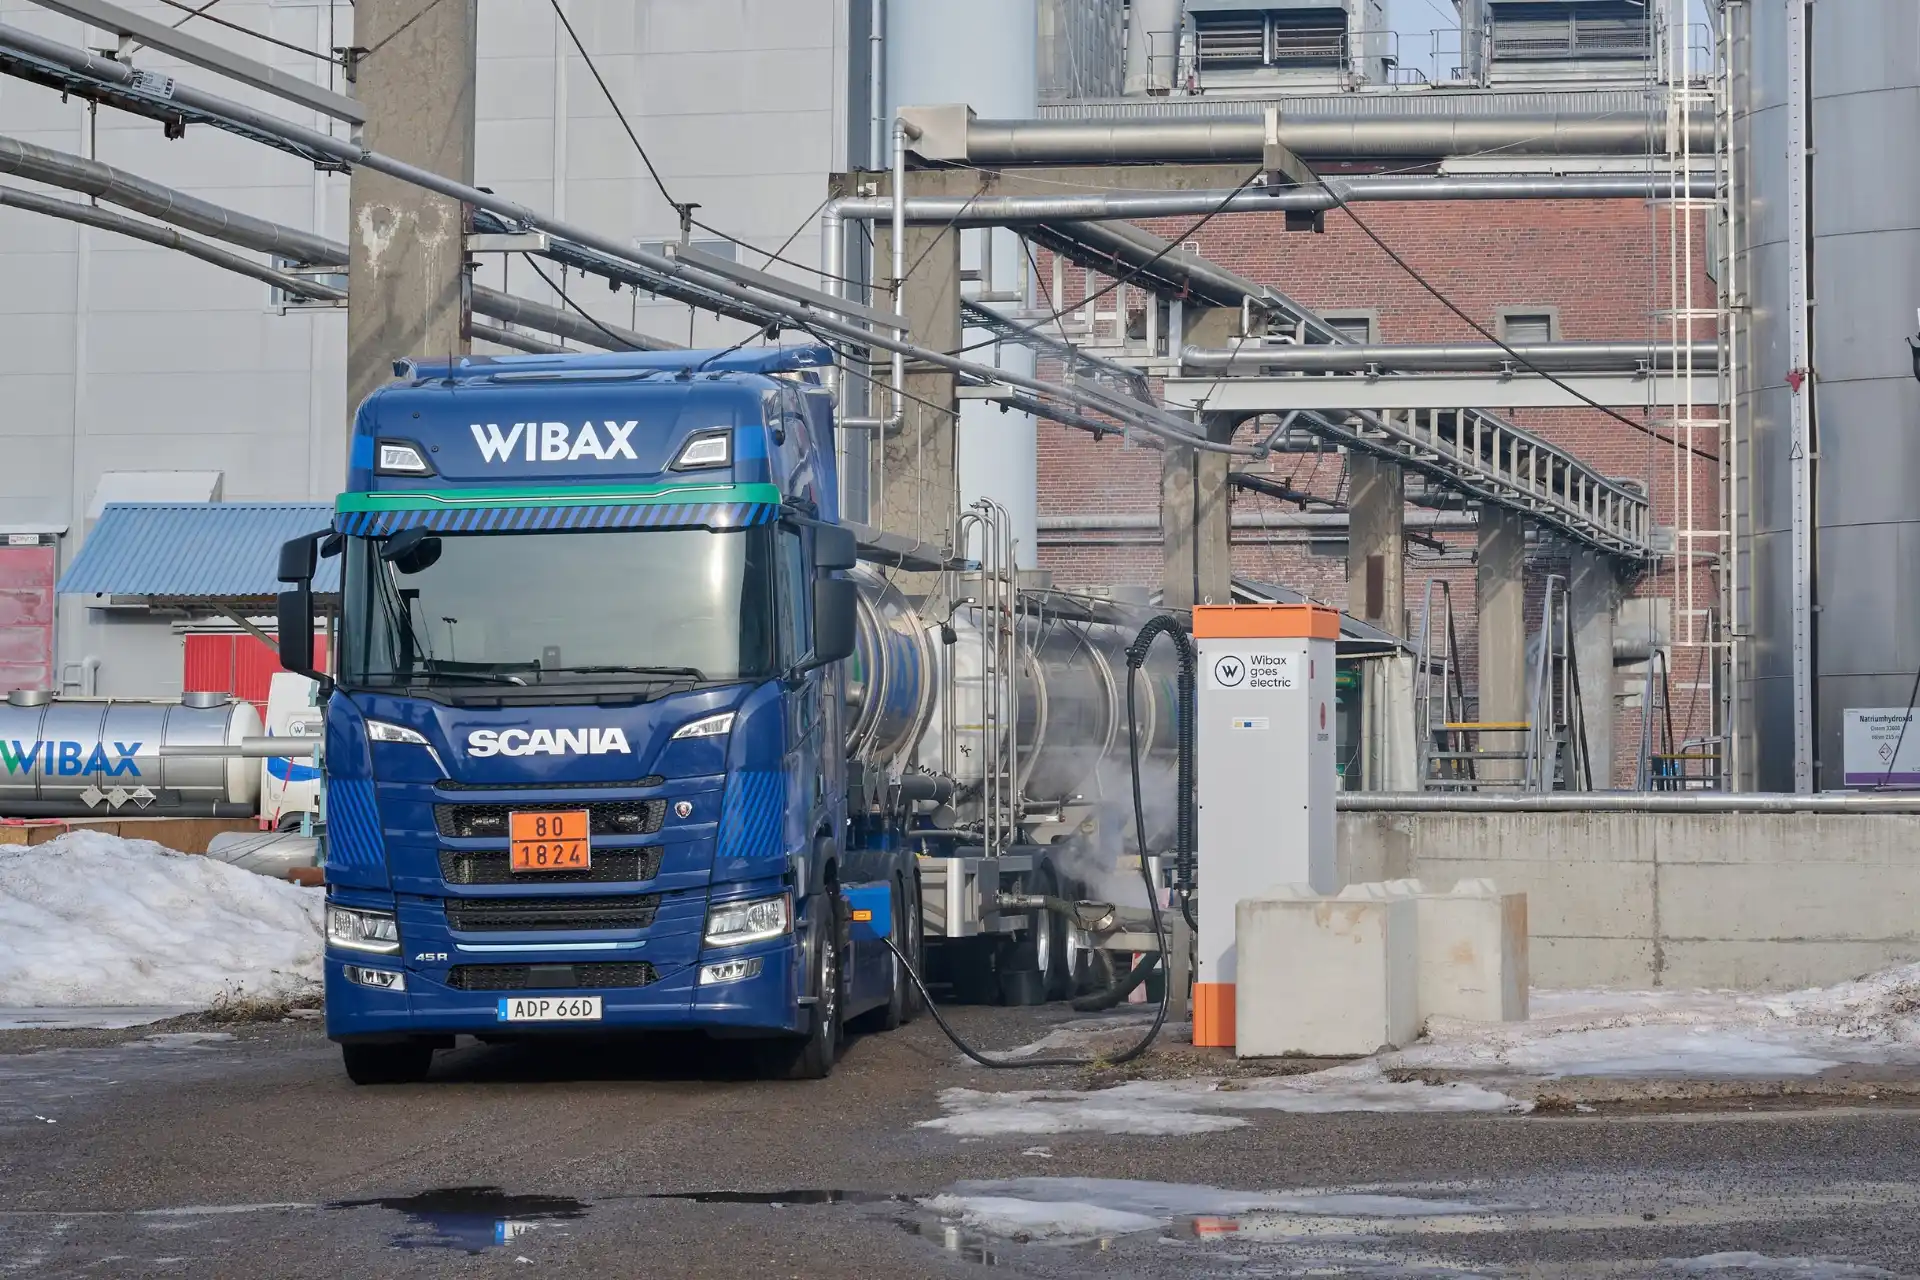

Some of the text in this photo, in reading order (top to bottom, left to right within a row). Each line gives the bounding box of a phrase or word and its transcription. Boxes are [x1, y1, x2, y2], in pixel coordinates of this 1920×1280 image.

[470, 421, 638, 463] WIBAX
[1250, 655, 1287, 665] Wibax
[1250, 668, 1278, 678] goes
[1250, 677, 1291, 687] electric
[1860, 715, 1912, 723] Natriumhydroxd
[467, 728, 632, 757] SCANIA
[0, 740, 143, 776] WIBAX
[535, 816, 563, 837] 80
[522, 844, 581, 867] 1824
[415, 953, 435, 961] 45
[514, 999, 593, 1017] ADP 66D
